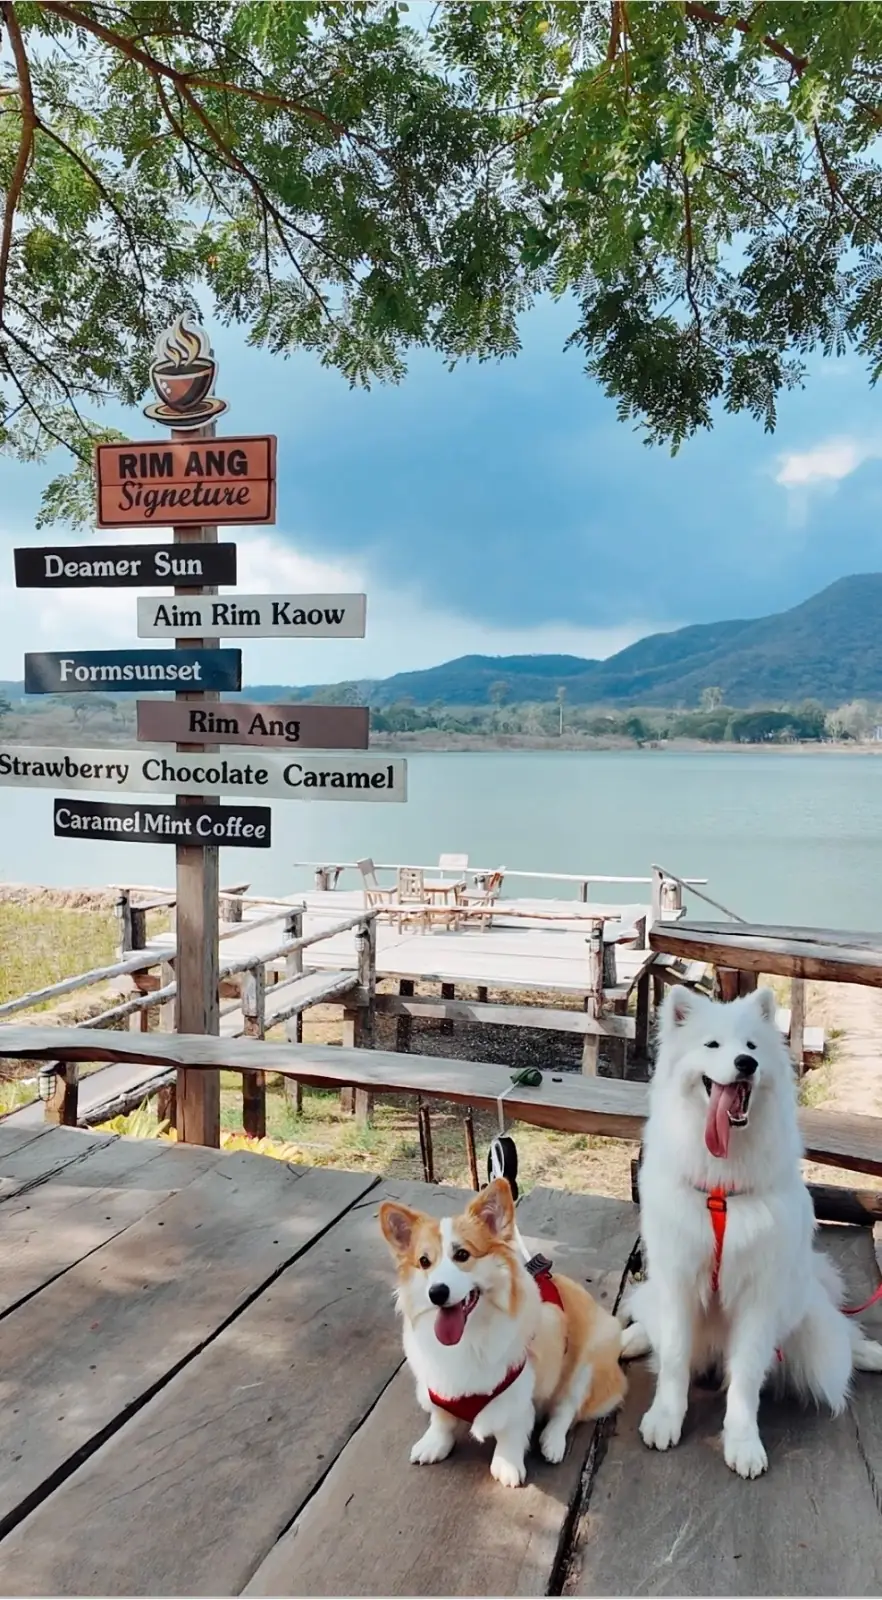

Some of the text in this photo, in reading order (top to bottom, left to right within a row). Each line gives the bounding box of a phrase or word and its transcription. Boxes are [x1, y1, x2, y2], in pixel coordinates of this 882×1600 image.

[119, 450, 248, 479] RIM ANG
[118, 481, 250, 518] Signeture
[44, 551, 203, 578] Deamer Sun
[153, 602, 346, 626] Aim Rim Kaow
[59, 659, 202, 682] Formsunset
[189, 710, 301, 742] Rim Ang
[0, 753, 394, 789] Strawberry Chocolate Caramel
[55, 808, 266, 839] Caramel Mint Coffee
